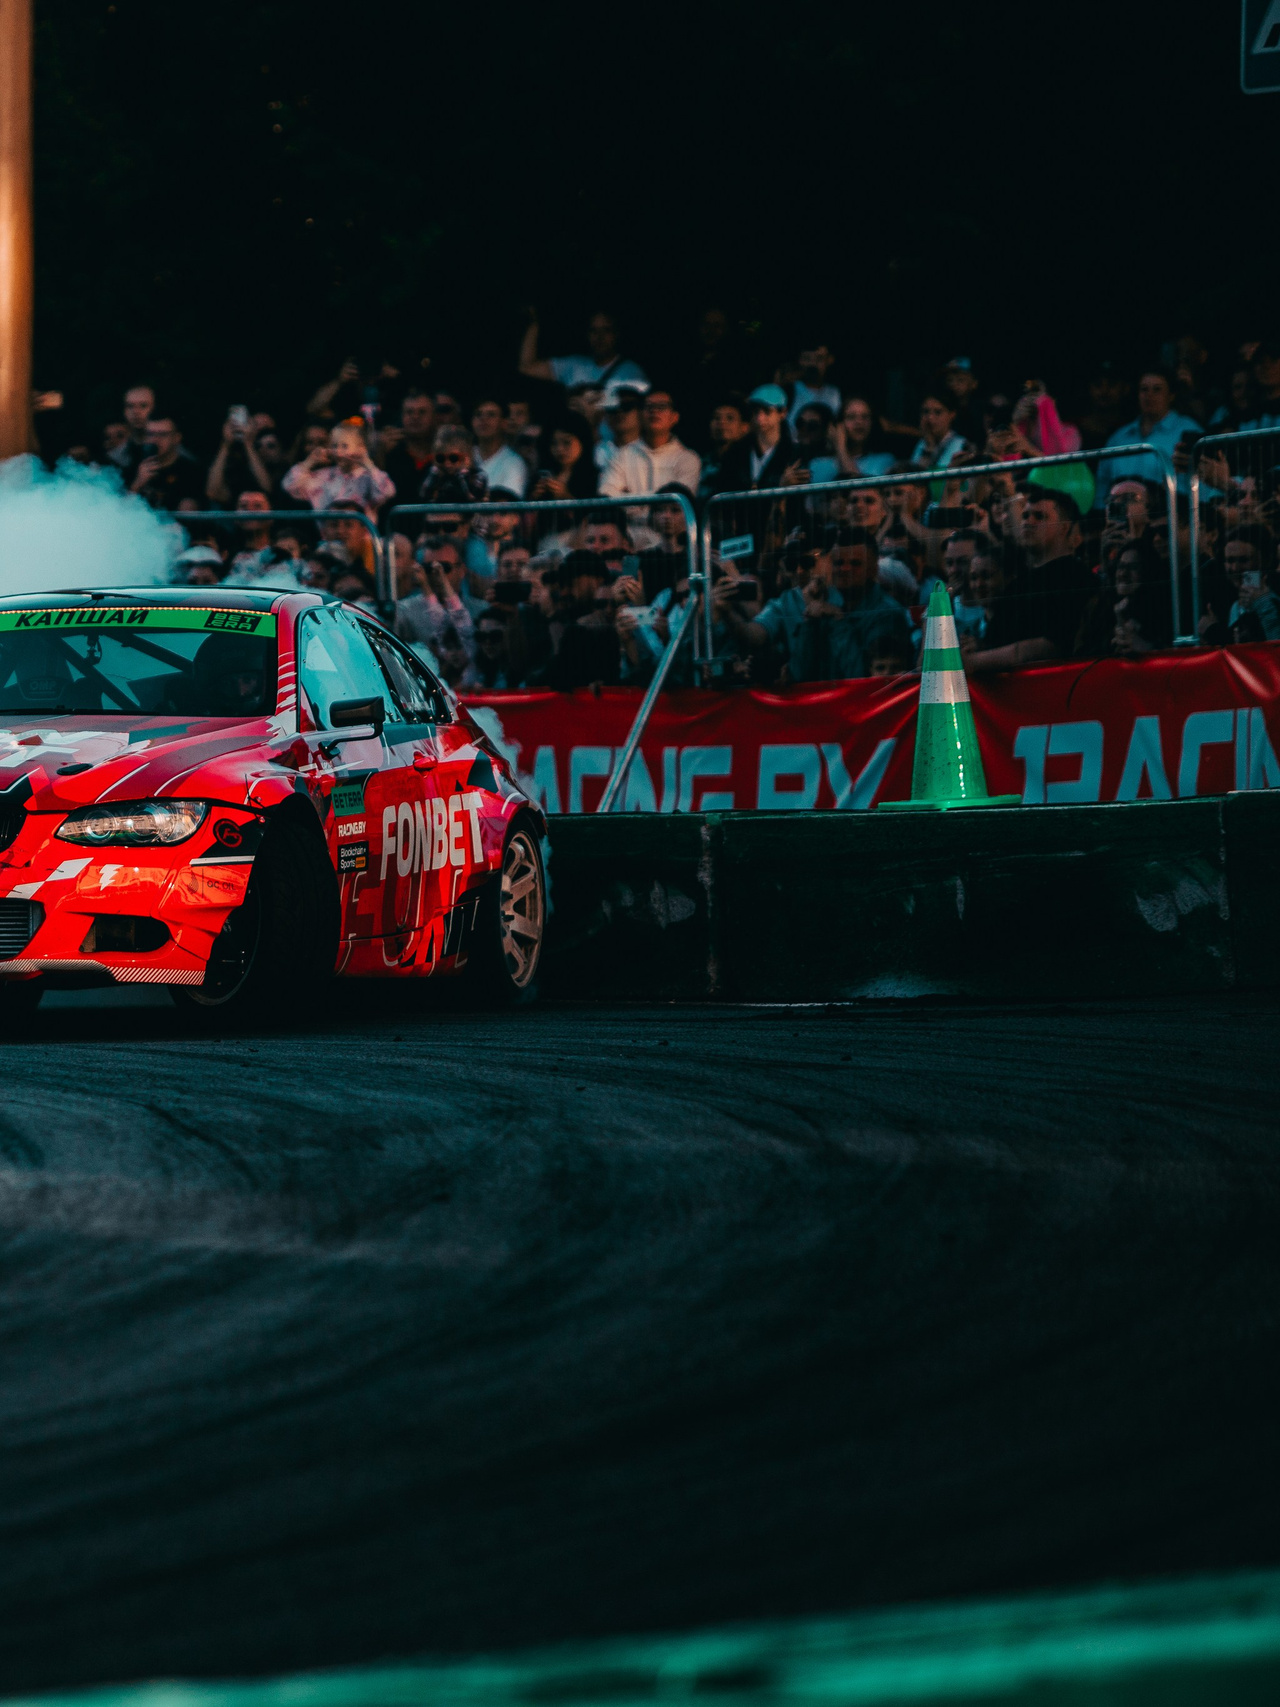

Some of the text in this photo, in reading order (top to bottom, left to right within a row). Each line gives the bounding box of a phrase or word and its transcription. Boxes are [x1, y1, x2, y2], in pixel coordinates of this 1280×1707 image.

[214, 612, 256, 623] BET
[379, 791, 485, 881] FONBET
[340, 859, 356, 871] Sports
